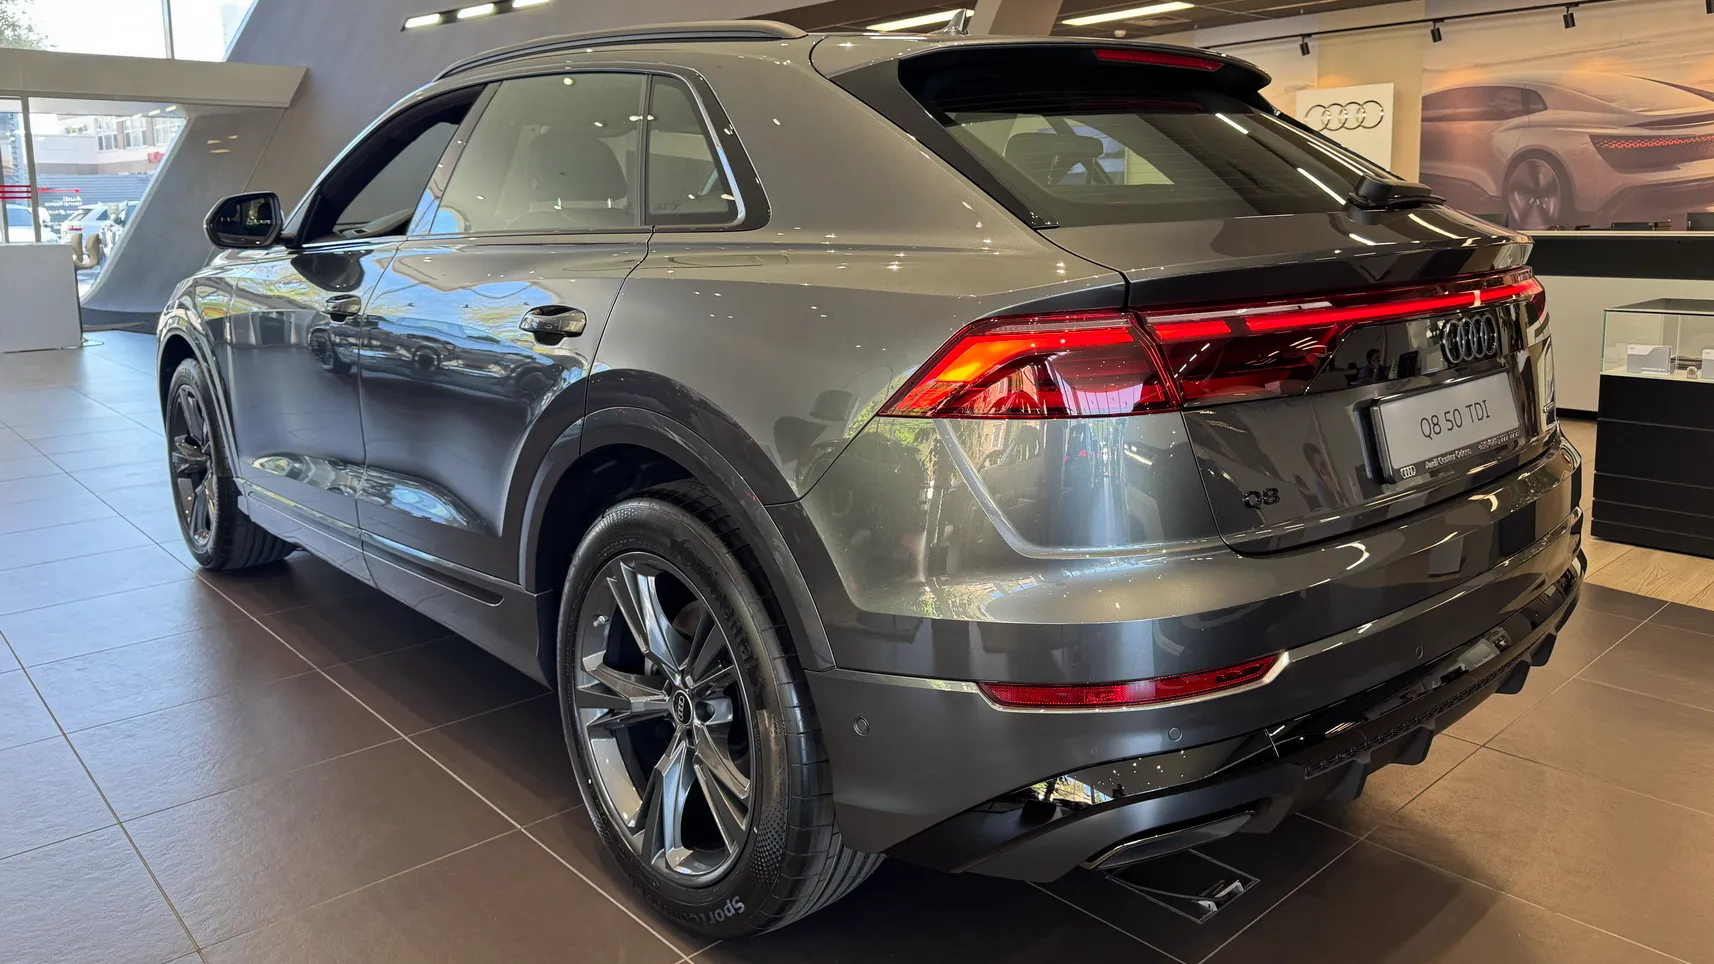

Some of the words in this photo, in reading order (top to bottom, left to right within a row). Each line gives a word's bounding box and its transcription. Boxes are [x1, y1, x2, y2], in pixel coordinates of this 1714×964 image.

[1420, 414, 1442, 440] Q8
[1444, 408, 1463, 431] 50
[1465, 399, 1490, 423] TDI
[1425, 459, 1439, 470] Audi
[1243, 487, 1280, 510] Q8
